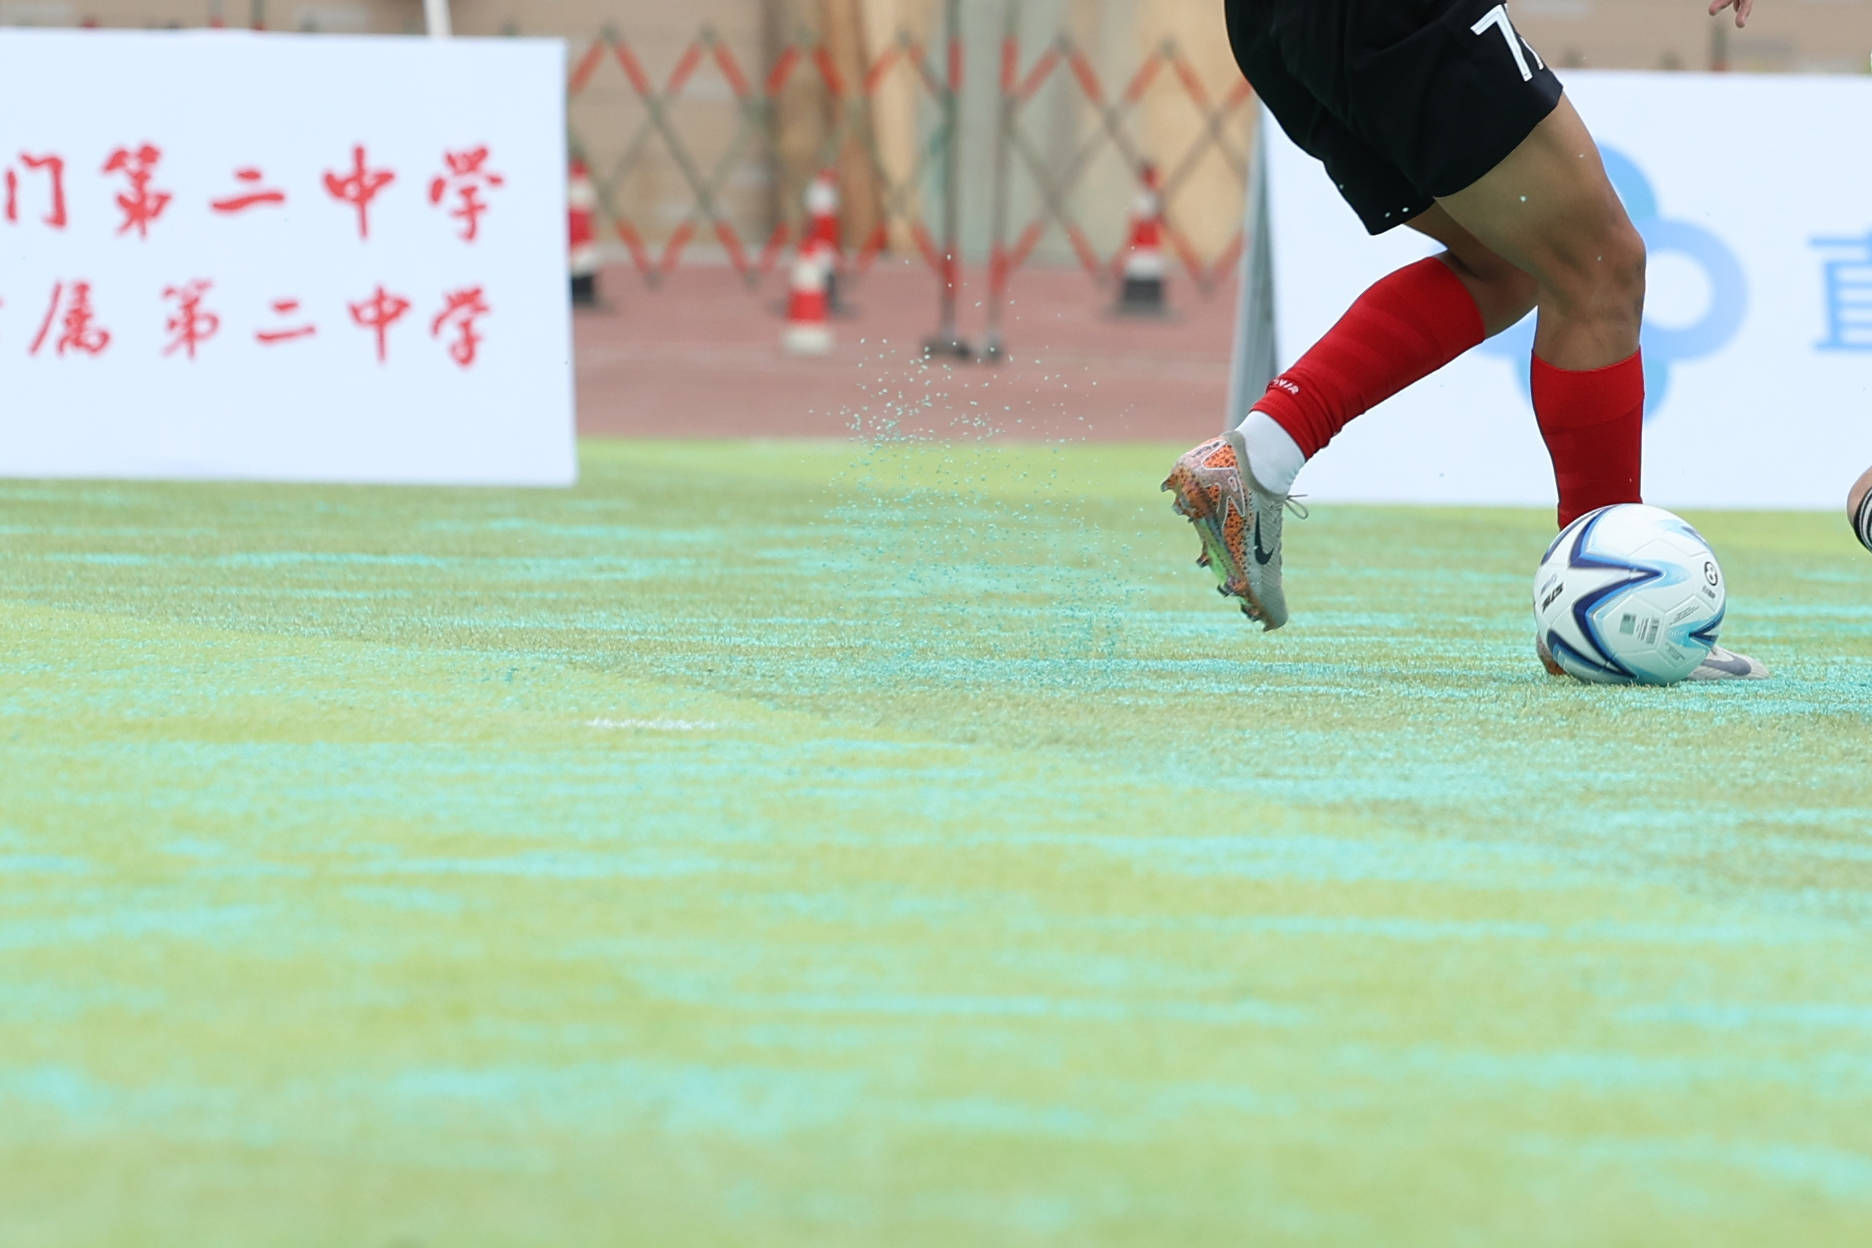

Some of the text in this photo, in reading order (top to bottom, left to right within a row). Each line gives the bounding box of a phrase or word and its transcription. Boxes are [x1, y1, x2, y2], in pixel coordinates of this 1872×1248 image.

[1470, 3, 1544, 82] 7
[3, 140, 505, 243] 门第二中学
[0, 278, 490, 369] 属第二中学
